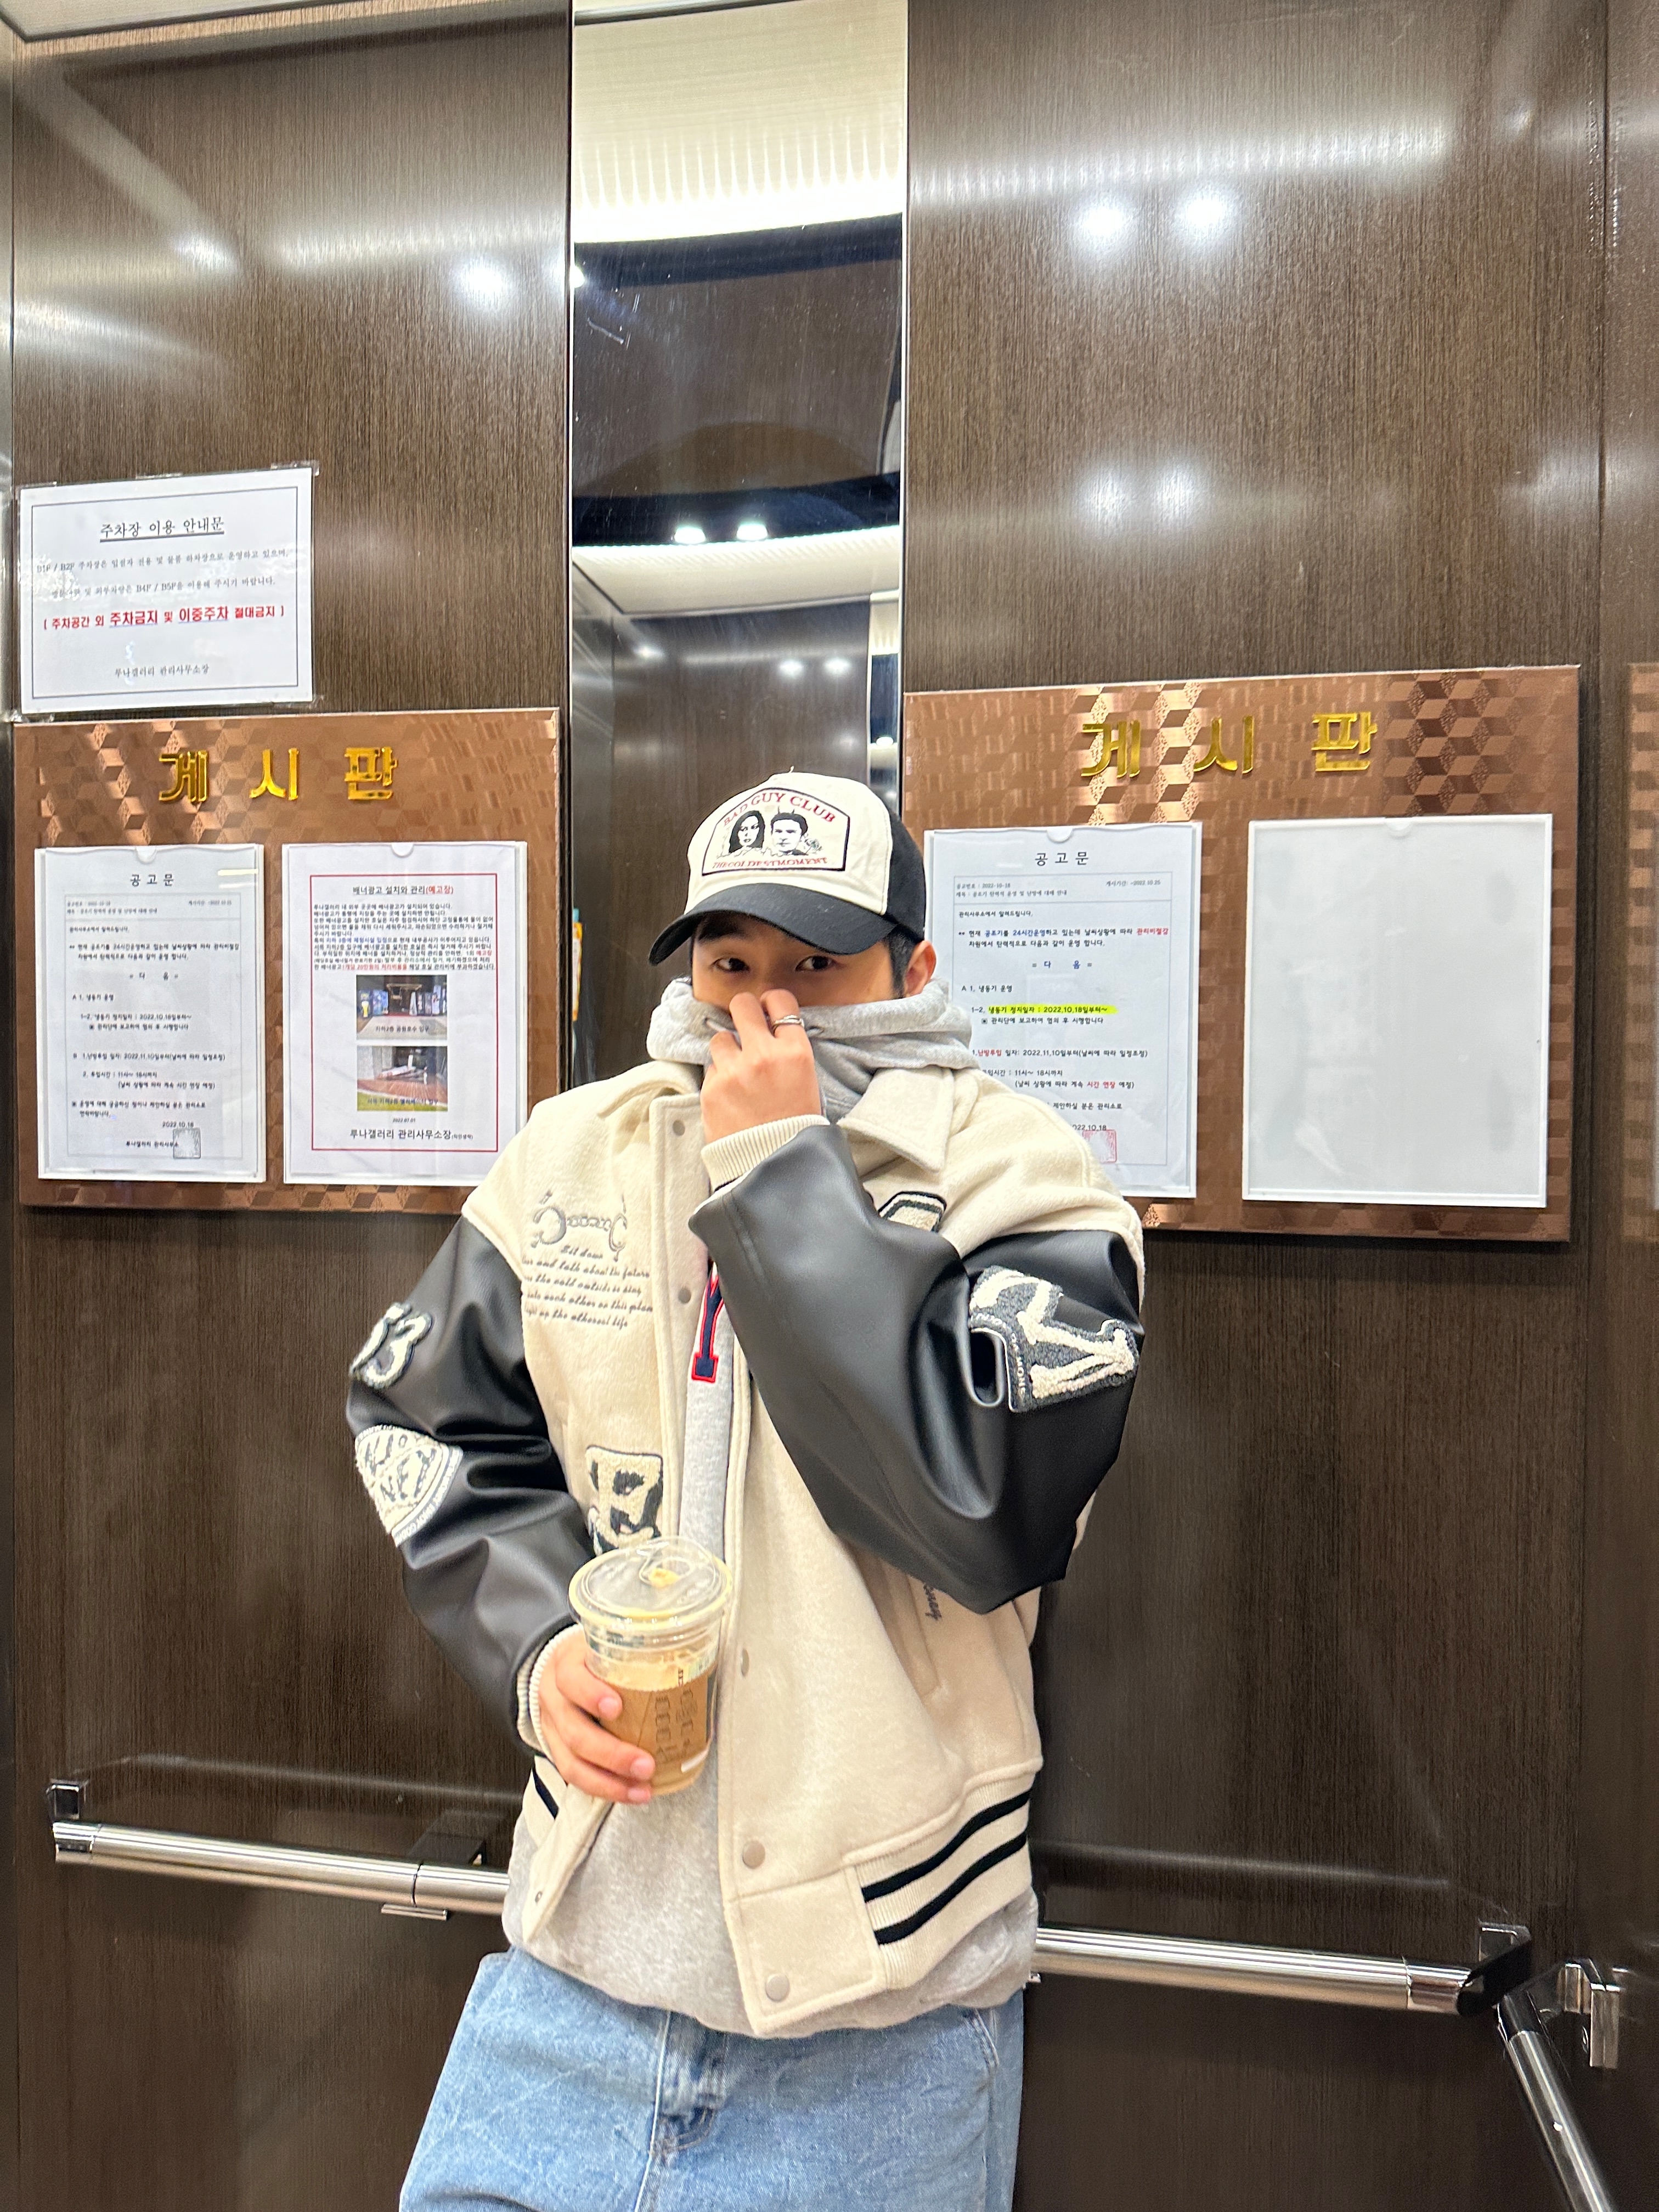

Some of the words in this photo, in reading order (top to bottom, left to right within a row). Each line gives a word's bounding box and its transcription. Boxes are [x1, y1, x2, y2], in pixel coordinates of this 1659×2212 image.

[101, 522, 141, 537] 주차장
[150, 520, 175, 535] 이용
[184, 517, 224, 534] 안내문
[52, 616, 89, 629] 주차공간
[95, 615, 104, 627] 외
[110, 610, 157, 627] 주차금지
[164, 611, 172, 623] 및
[179, 606, 229, 623] 이중주차
[235, 606, 274, 619] 절대금지
[723, 803, 748, 827] BAD
[751, 792, 786, 806] GUY
[789, 796, 836, 823] CLUB
[353, 886, 383, 895] 배너광고
[386, 885, 408, 895] 설치와
[1013, 929, 1058, 937] 24시간운영하고
[1085, 928, 1115, 936] 날씨상황에
[1068, 939, 1080, 947] 운영
[1015, 1080, 1029, 1088] (날씨
[1087, 1081, 1099, 1089] 시간
[1081, 1102, 1093, 1110] 분은
[350, 1129, 393, 1139] 루나갤러리
[537, 1259, 558, 1268] and
[559, 1261, 580, 1271] talk
[535, 1274, 550, 1283] the
[553, 1308, 567, 1318] the
[613, 1317, 628, 1330] life
